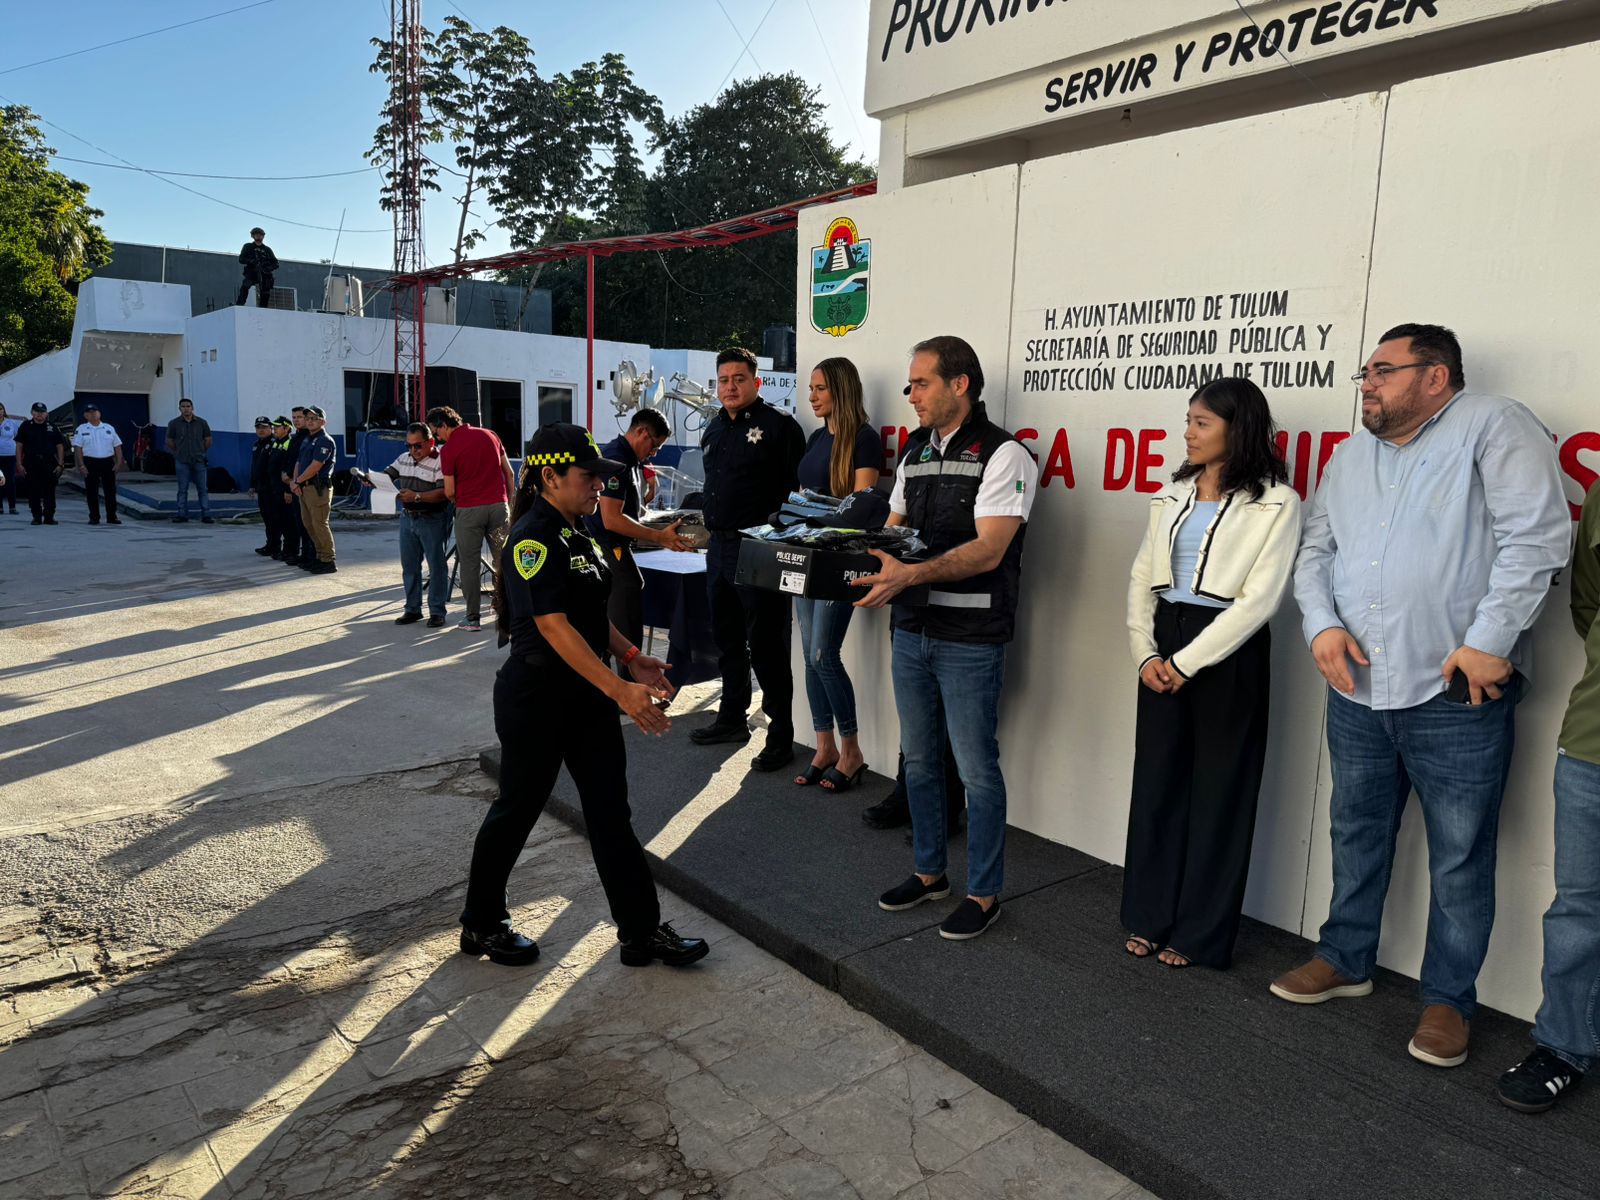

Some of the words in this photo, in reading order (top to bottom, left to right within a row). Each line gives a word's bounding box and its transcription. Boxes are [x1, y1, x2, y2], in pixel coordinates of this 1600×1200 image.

[1045, 53, 1158, 113] SERVIR
[1173, 41, 1196, 82] Y
[1202, 0, 1438, 73] PROTEGER
[1045, 308, 1058, 331] H.
[1061, 297, 1196, 330] AYUNTAMIENTO
[1203, 295, 1224, 321] DE
[1230, 290, 1289, 319] TULUM
[1025, 328, 1110, 362] SECRETARÍA
[1116, 334, 1134, 359] DE
[1140, 329, 1217, 358] SEGURIDAD
[1229, 319, 1306, 354] PÚBLICA
[1316, 324, 1333, 350] Y
[1023, 361, 1116, 392] PROTECCIÓN
[1124, 363, 1224, 390] CIUDADANA
[1260, 360, 1335, 388] TULUM
[1103, 428, 1167, 493] DE
